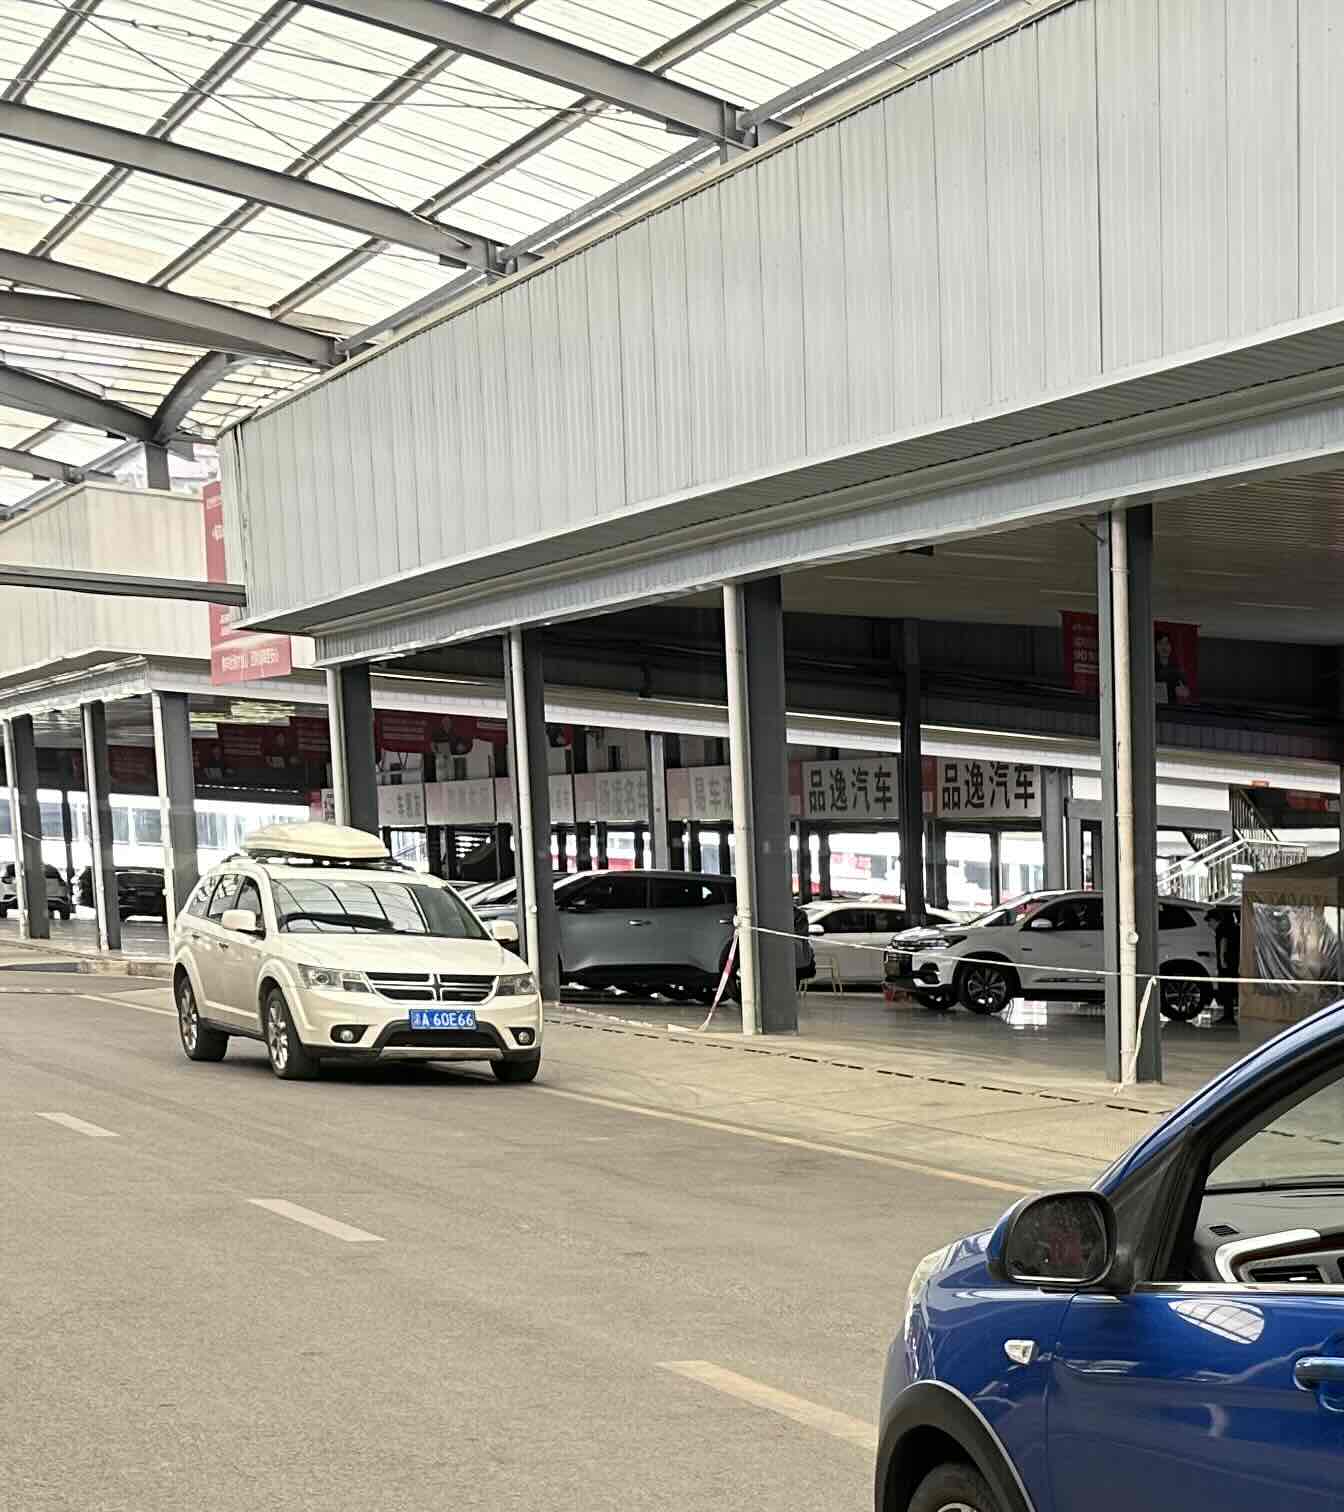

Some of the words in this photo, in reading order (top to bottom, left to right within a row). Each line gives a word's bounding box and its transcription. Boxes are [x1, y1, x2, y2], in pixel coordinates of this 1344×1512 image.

[809, 766, 893, 814] 品逸汽车
[942, 762, 1036, 811] 品逸汽车
